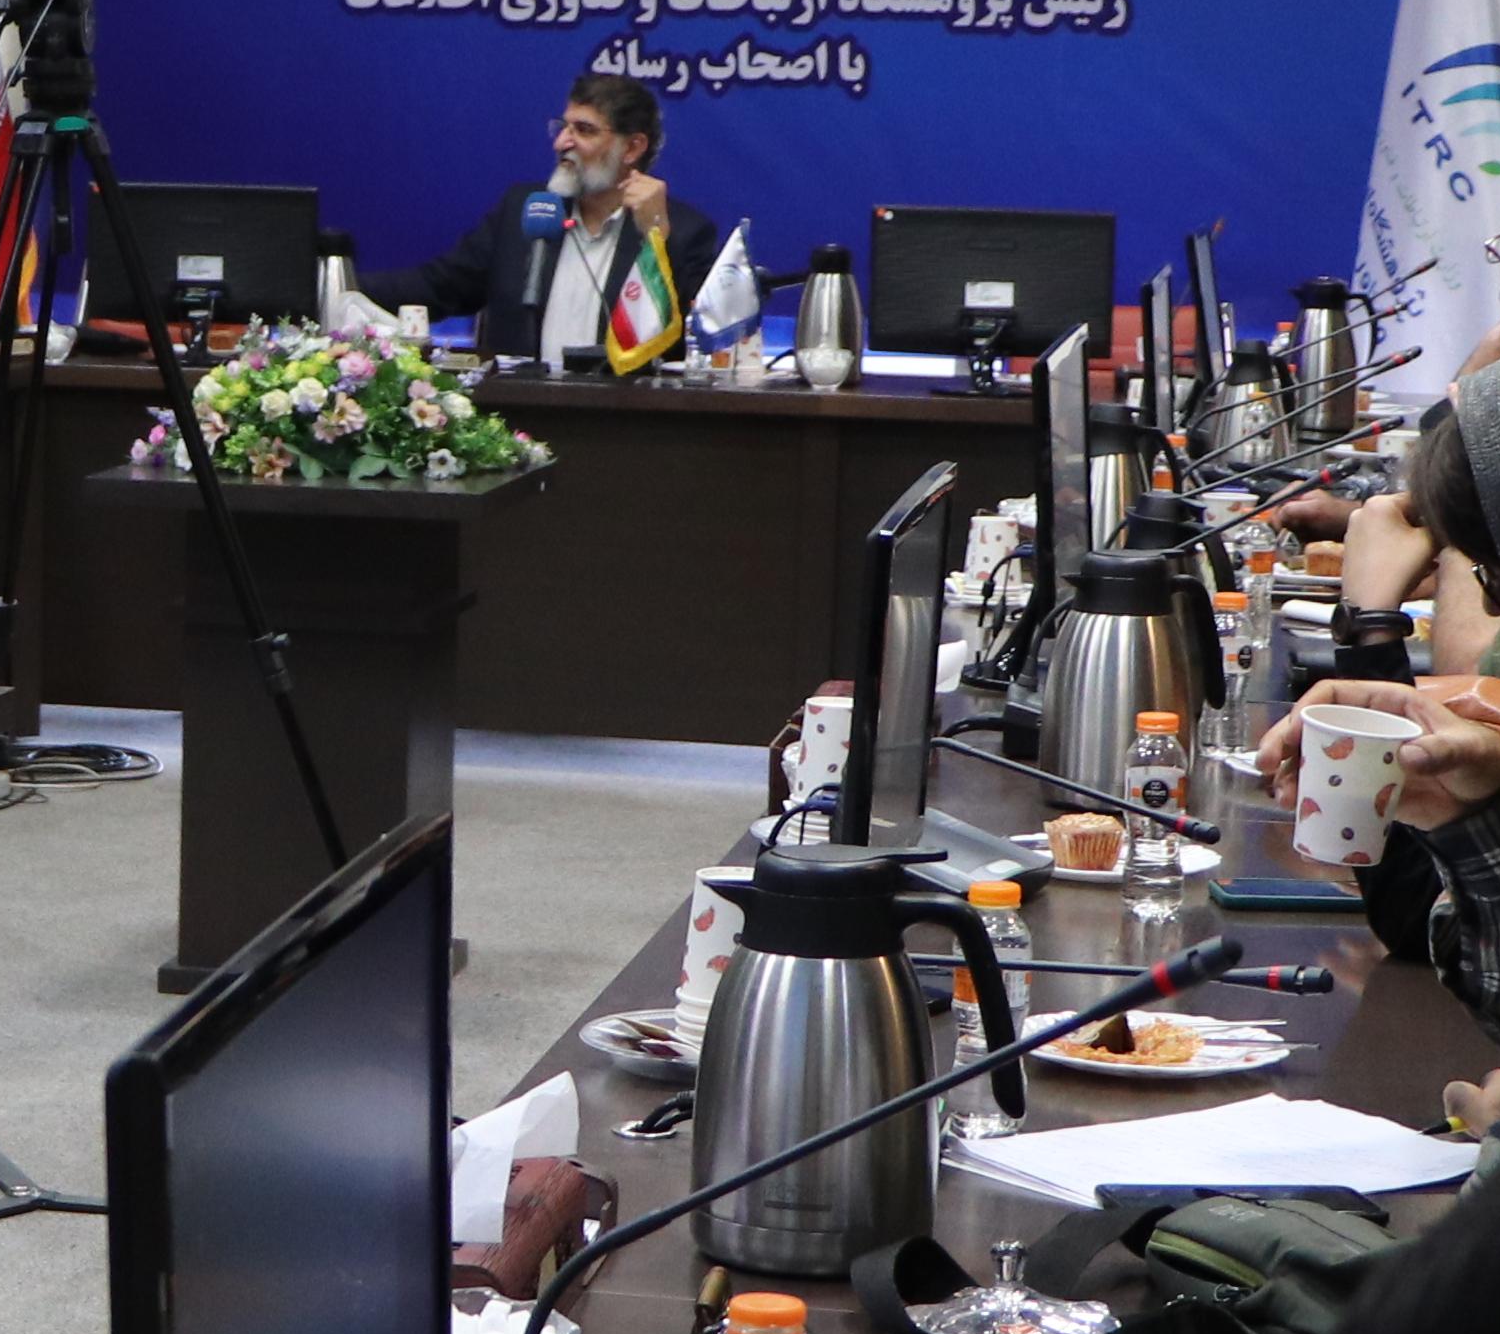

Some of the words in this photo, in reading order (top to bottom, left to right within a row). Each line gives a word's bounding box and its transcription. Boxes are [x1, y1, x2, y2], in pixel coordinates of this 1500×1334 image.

[591, 39, 689, 92] رسانه
[699, 40, 828, 90] اصحاب
[838, 41, 865, 92] با
[1401, 81, 1475, 202] ITRC
